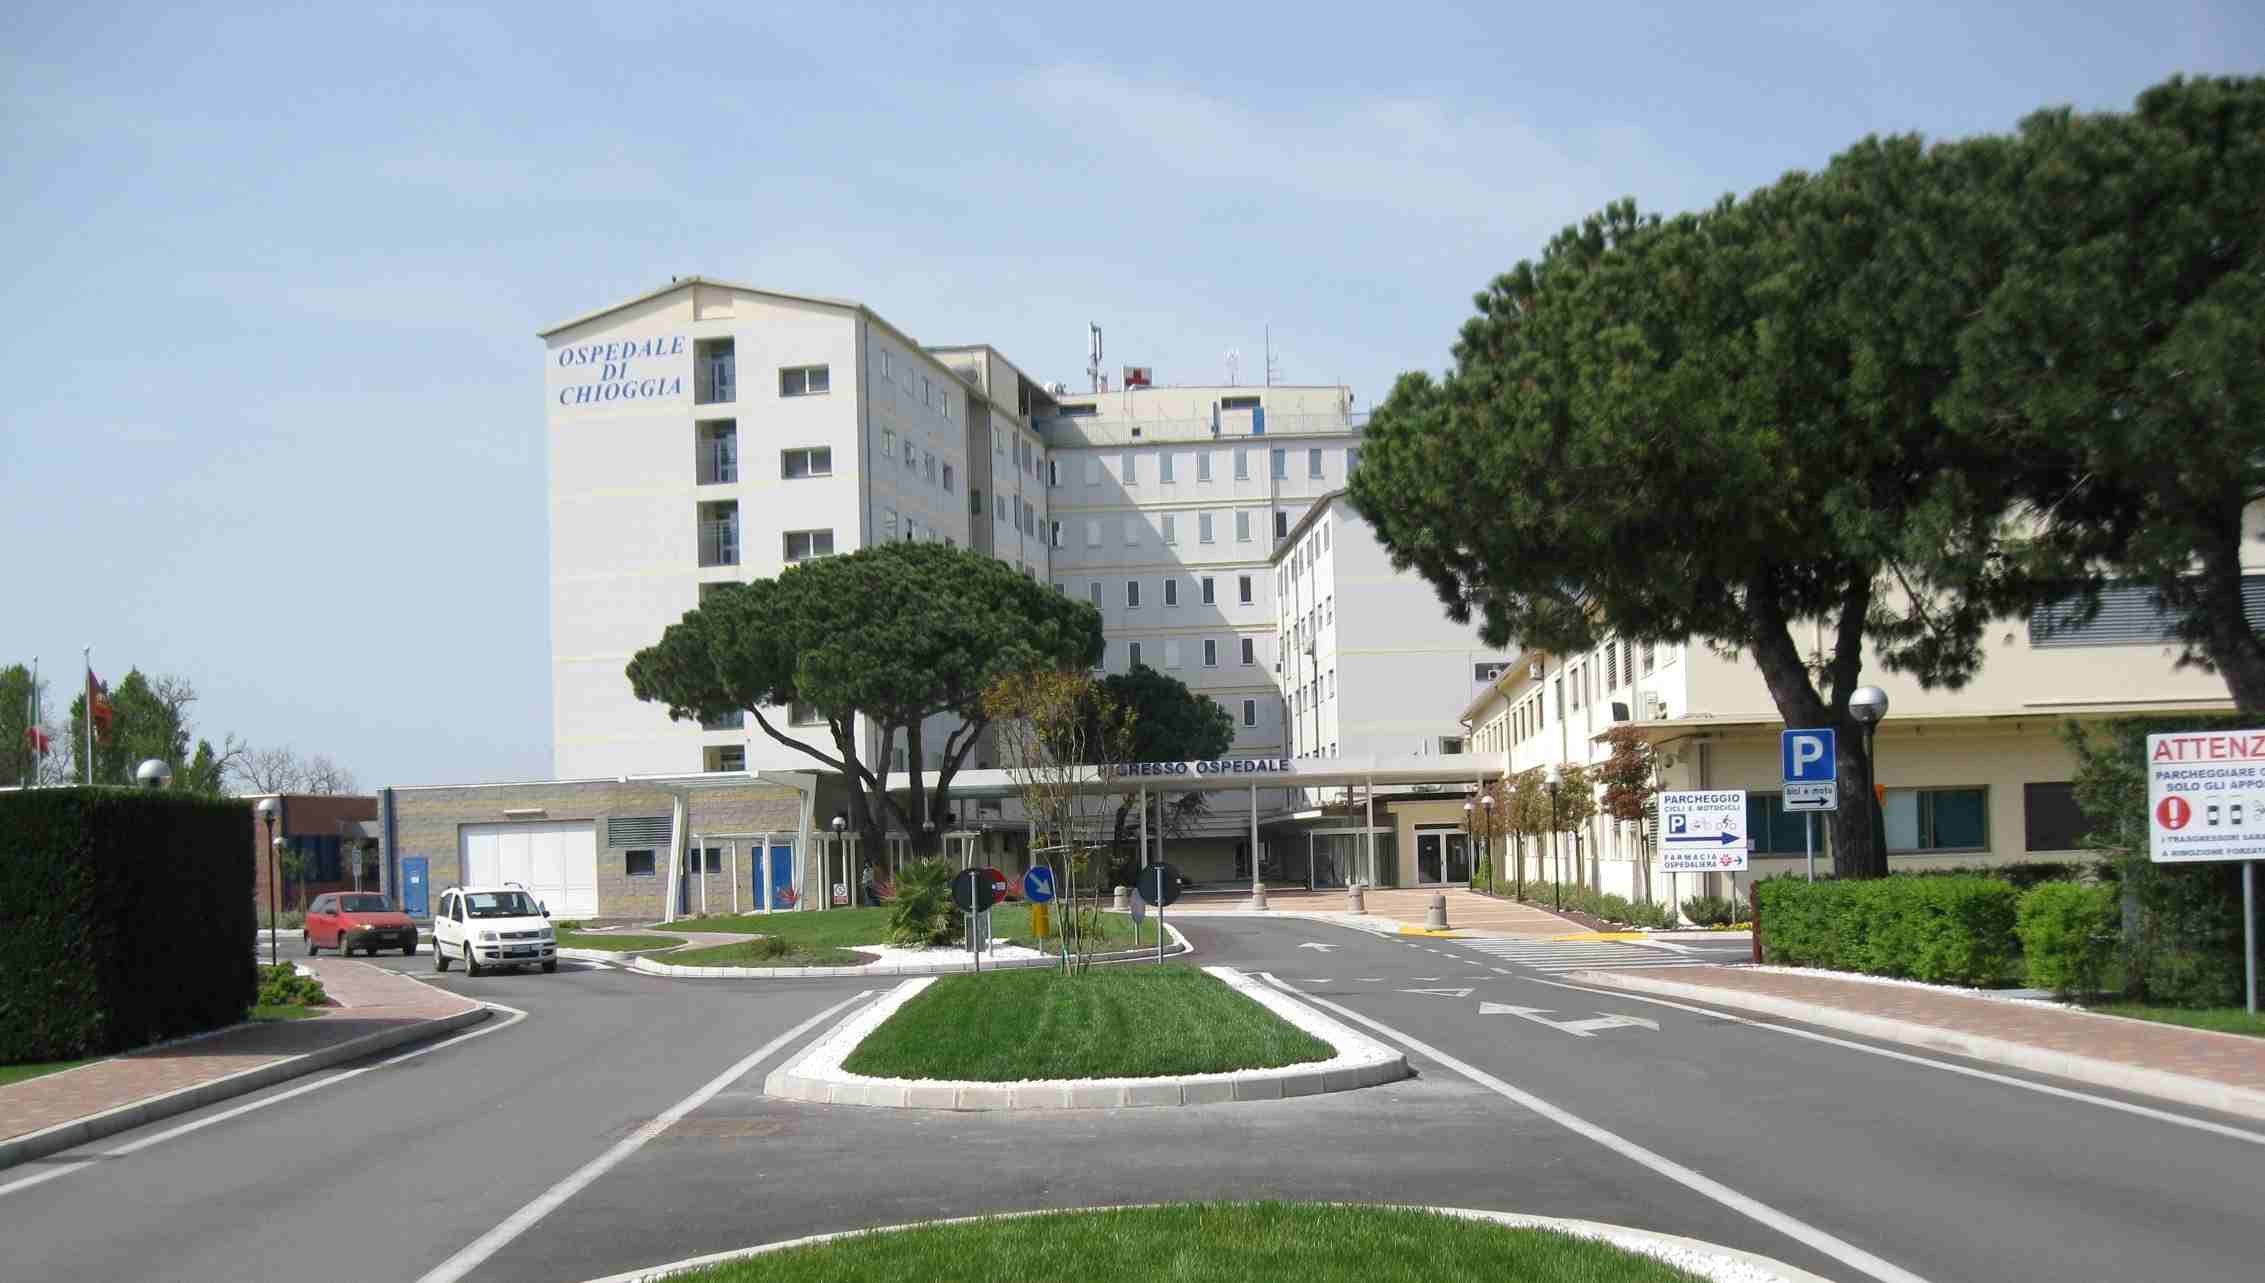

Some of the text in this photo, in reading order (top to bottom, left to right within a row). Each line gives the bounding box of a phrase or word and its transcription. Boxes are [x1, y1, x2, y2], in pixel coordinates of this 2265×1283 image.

[559, 336, 686, 367] OSPEDALE
[602, 362, 626, 381] DI
[559, 376, 681, 405] CHIOGGIA
[1793, 736, 1824, 776] P
[1098, 759, 1289, 777] GRESSO OSPEDALE
[2156, 768, 2256, 779] PARCHEGGIARE
[2167, 780, 2265, 791] SOLO GLI APPO
[1664, 794, 1741, 804] PARCHEGGIO
[1671, 816, 1686, 832] P
